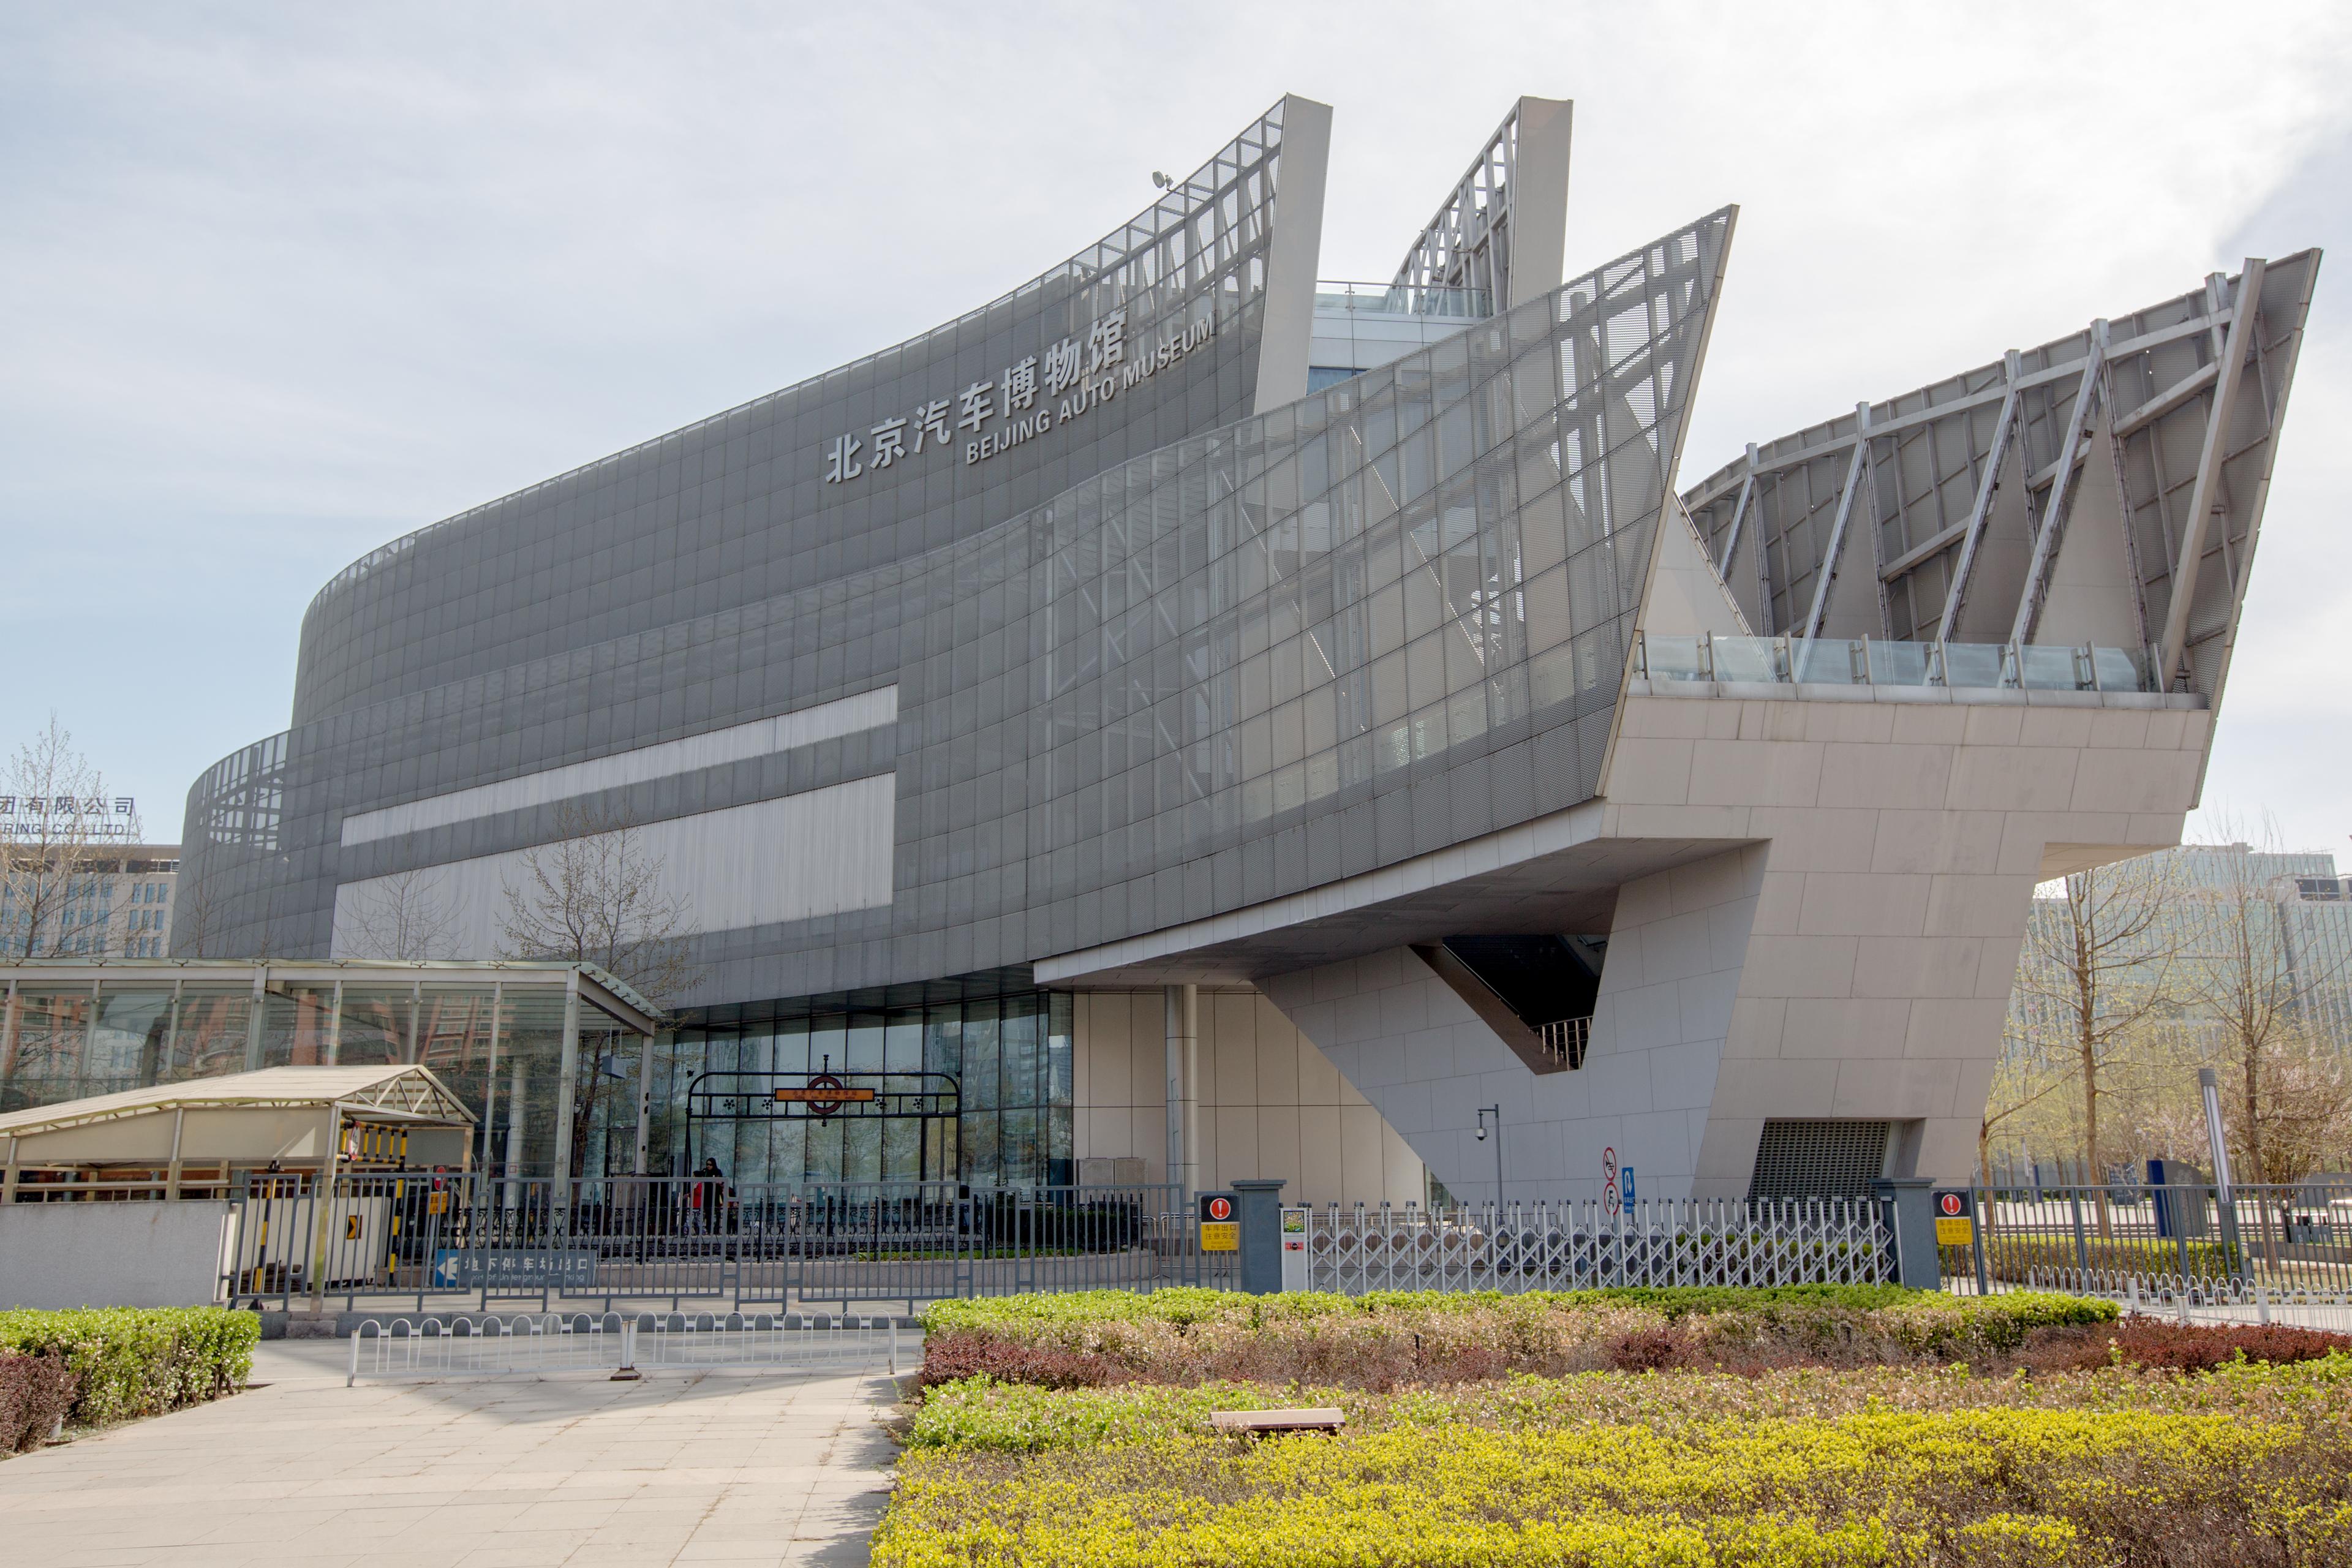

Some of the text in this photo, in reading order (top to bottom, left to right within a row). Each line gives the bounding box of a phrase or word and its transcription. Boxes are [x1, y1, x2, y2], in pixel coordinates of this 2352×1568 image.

[825, 309, 1127, 483] 北京汽车博物馆
[966, 311, 1216, 464] BEIJING AUTO MUSEUM
